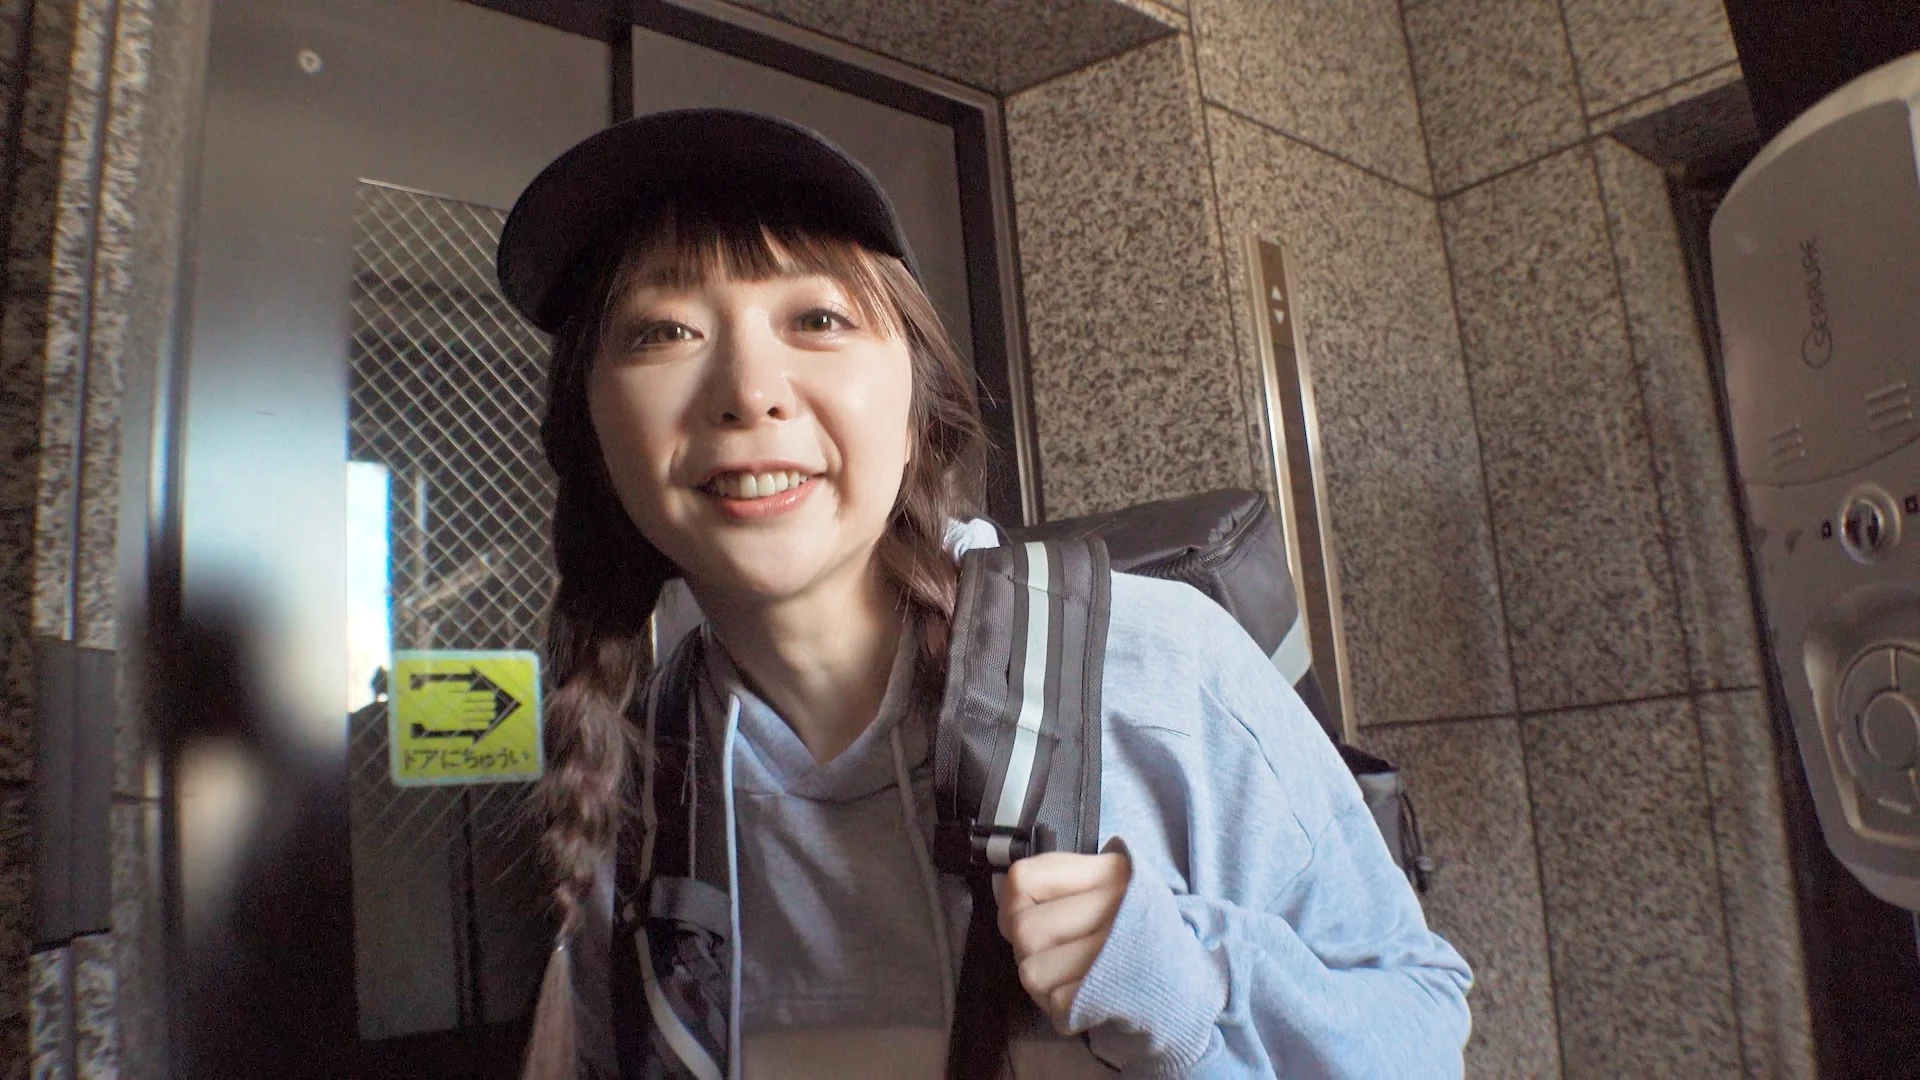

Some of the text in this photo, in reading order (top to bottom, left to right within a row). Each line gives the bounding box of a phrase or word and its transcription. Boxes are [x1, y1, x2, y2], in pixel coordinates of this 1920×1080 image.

[403, 746, 530, 772] ドアにちゅうい
